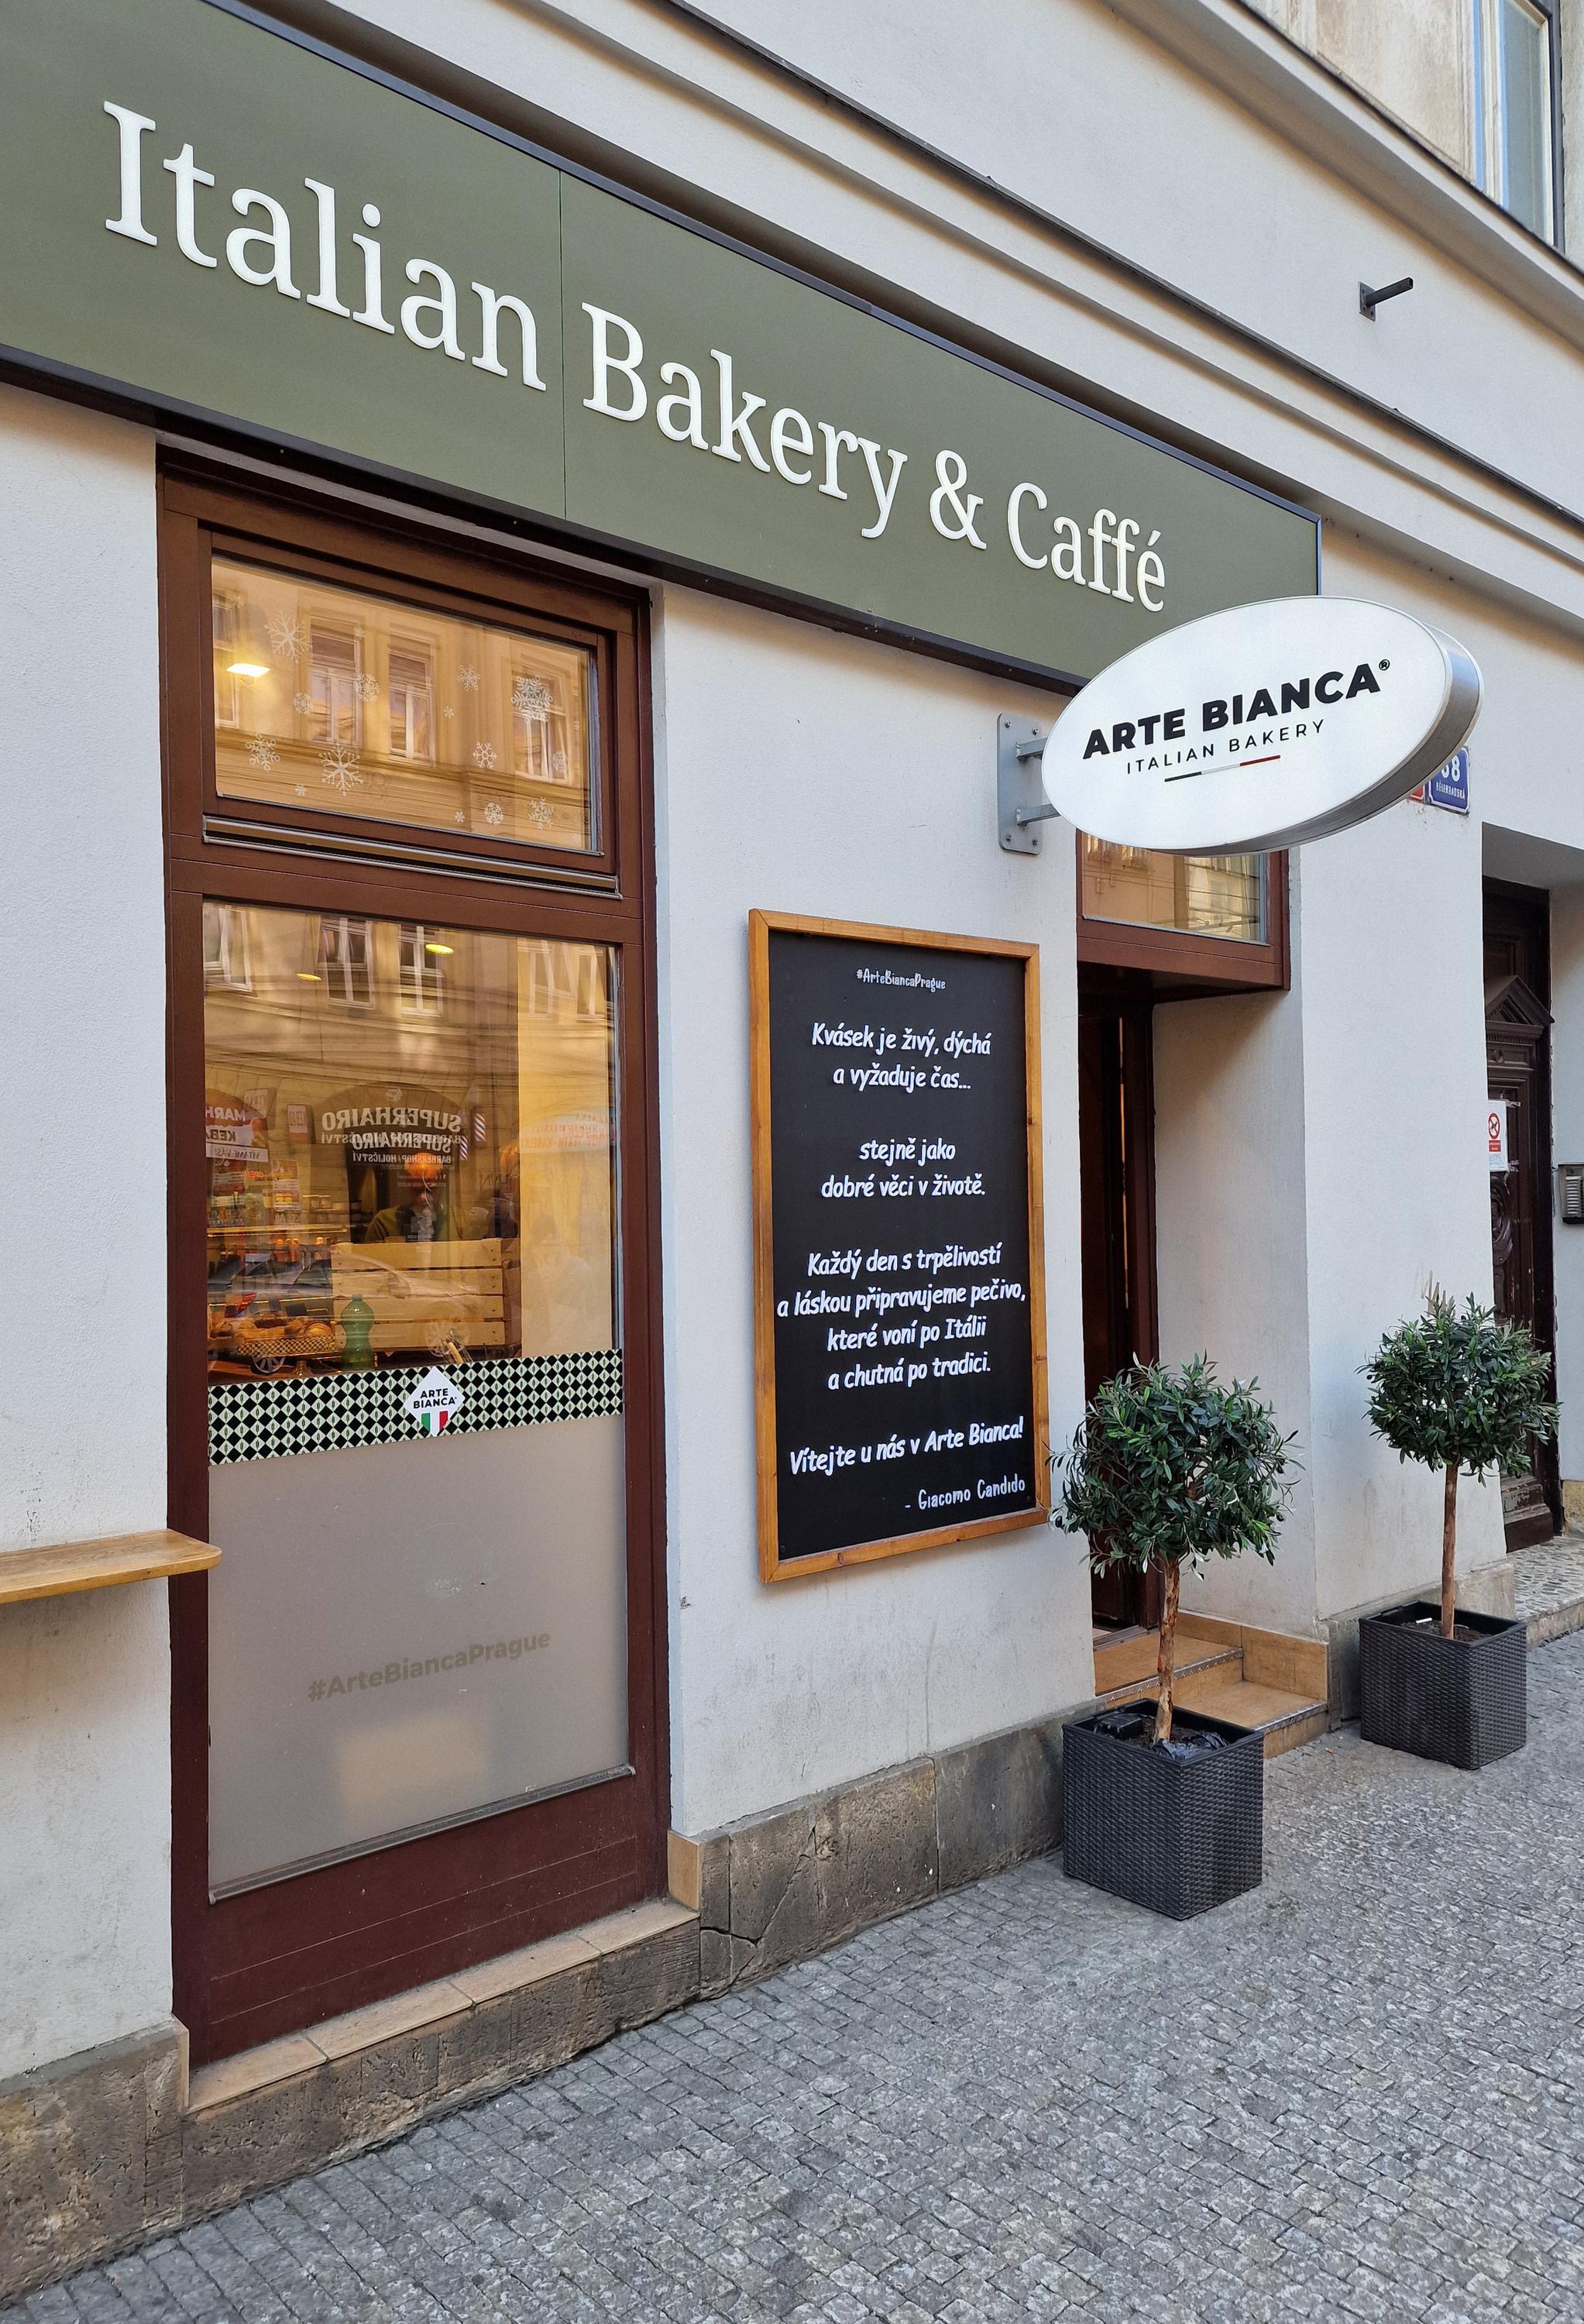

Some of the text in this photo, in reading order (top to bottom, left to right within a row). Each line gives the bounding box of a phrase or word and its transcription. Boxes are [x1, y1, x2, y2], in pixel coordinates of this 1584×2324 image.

[103, 100, 1165, 612] Italian Bakery & Caffé
[1083, 708, 1185, 759] ARTE
[1128, 719, 1324, 774] ITALIAN BAKERY
[857, 968, 945, 992] #ArteBiancaPrague
[813, 1023, 991, 1058] Kvásek je živý, dýchá
[833, 1062, 971, 1093] a vyžaduje čas...
[859, 1137, 955, 1166] stejně jako
[821, 1173, 985, 1198] dobré věci v životě.
[808, 1242, 1002, 1280] Každý den s trpělivostí
[777, 1278, 1025, 1318] a láskou připravujeme pečivo,
[827, 1315, 986, 1351] které voní po Itálii
[828, 1352, 990, 1390] a chutná po tradici.
[421, 1388, 448, 1399] ARTE
[791, 1416, 1023, 1476] Vítejte u nás v Arte Bianca!
[919, 1490, 971, 1509] Giacomo
[978, 1473, 1025, 1498] Candido
[308, 1632, 550, 1701] #ArteBiancaPrague
